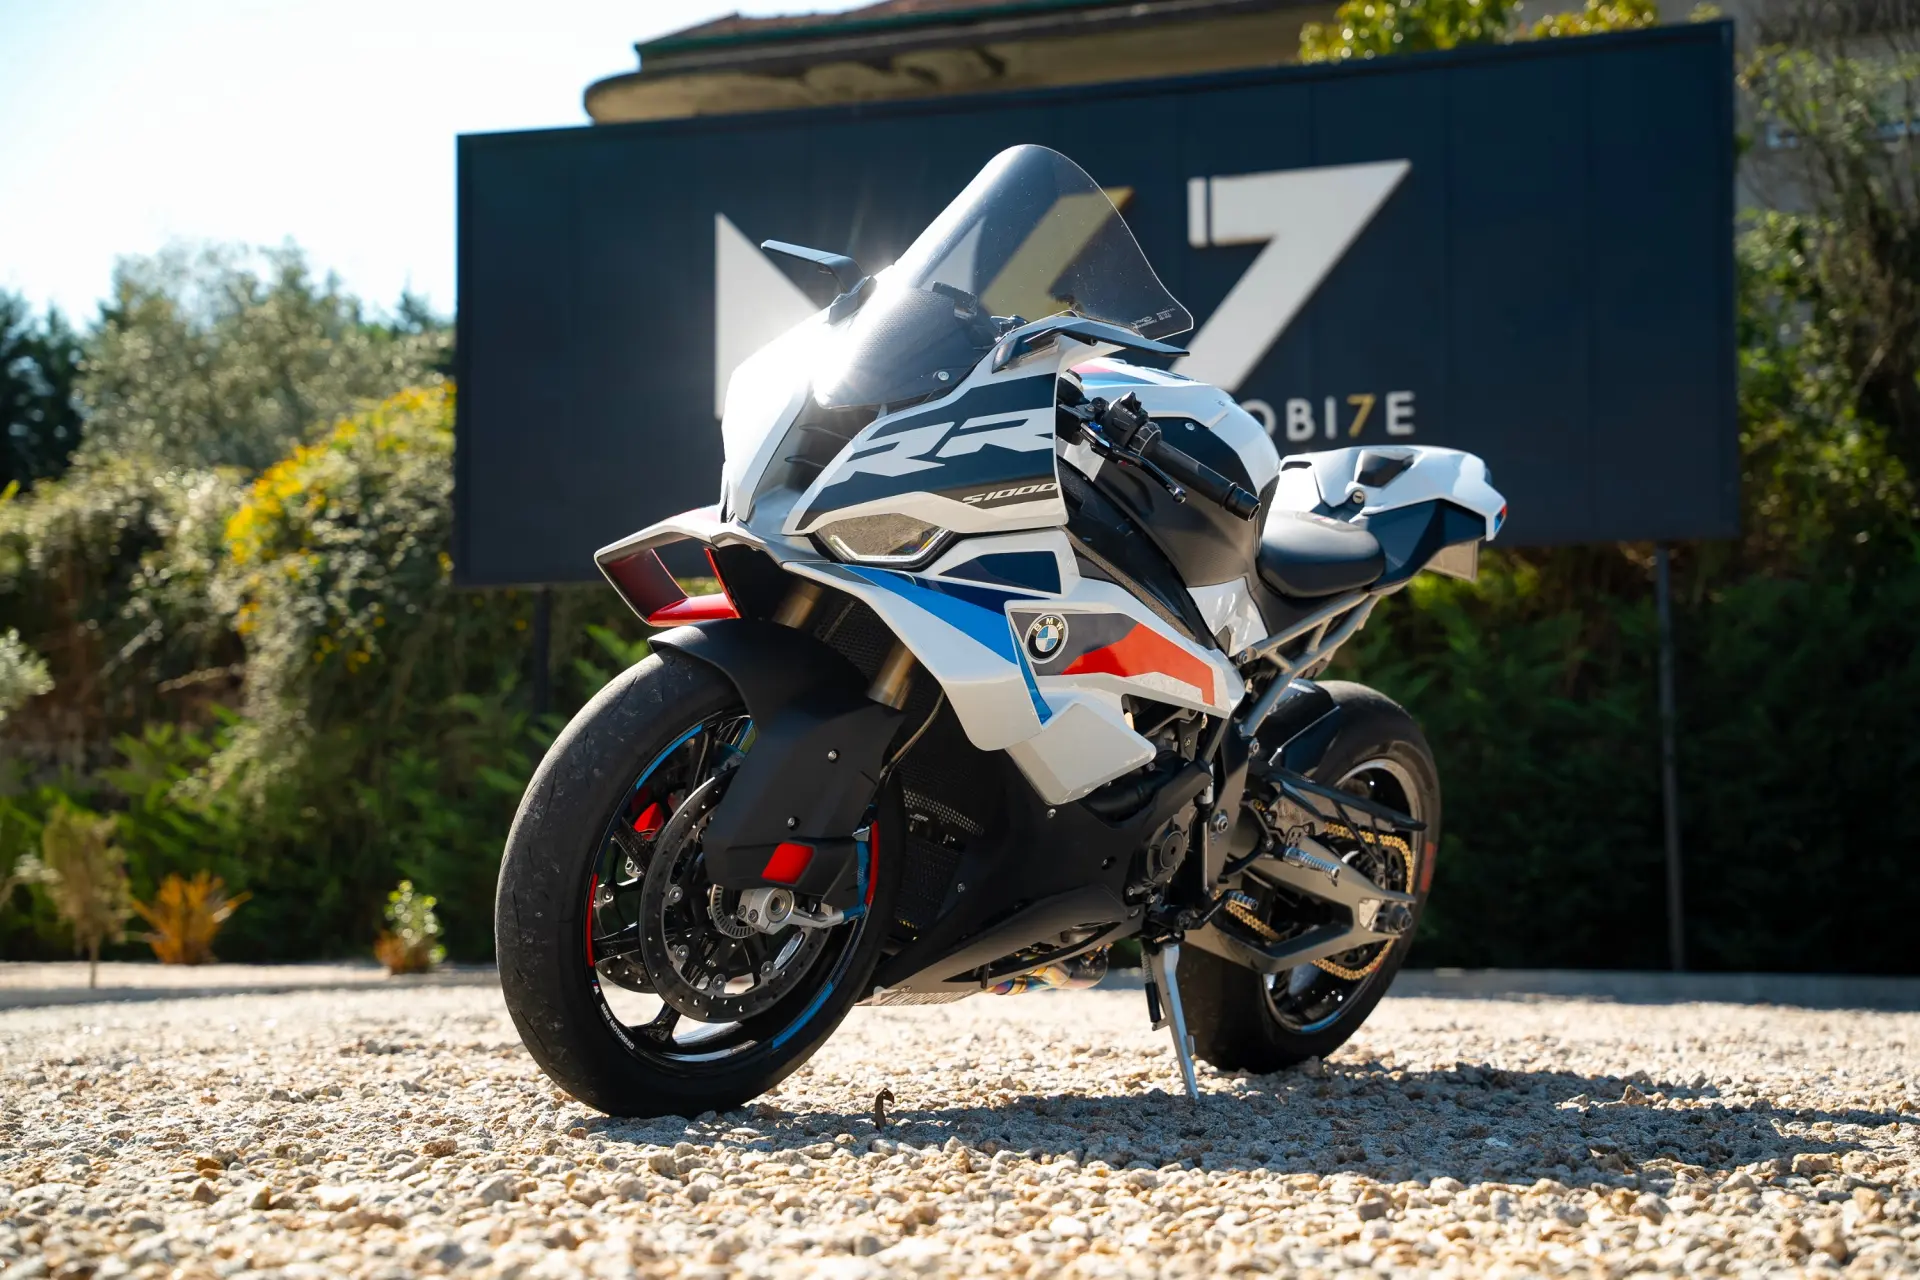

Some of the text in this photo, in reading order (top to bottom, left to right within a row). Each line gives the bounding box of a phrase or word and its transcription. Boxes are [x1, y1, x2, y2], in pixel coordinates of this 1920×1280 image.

[824, 407, 1055, 488] RR
[961, 482, 1058, 506] S1000
[1033, 617, 1064, 632] BMW
[600, 1003, 635, 1050] BMW MOTORRAD
